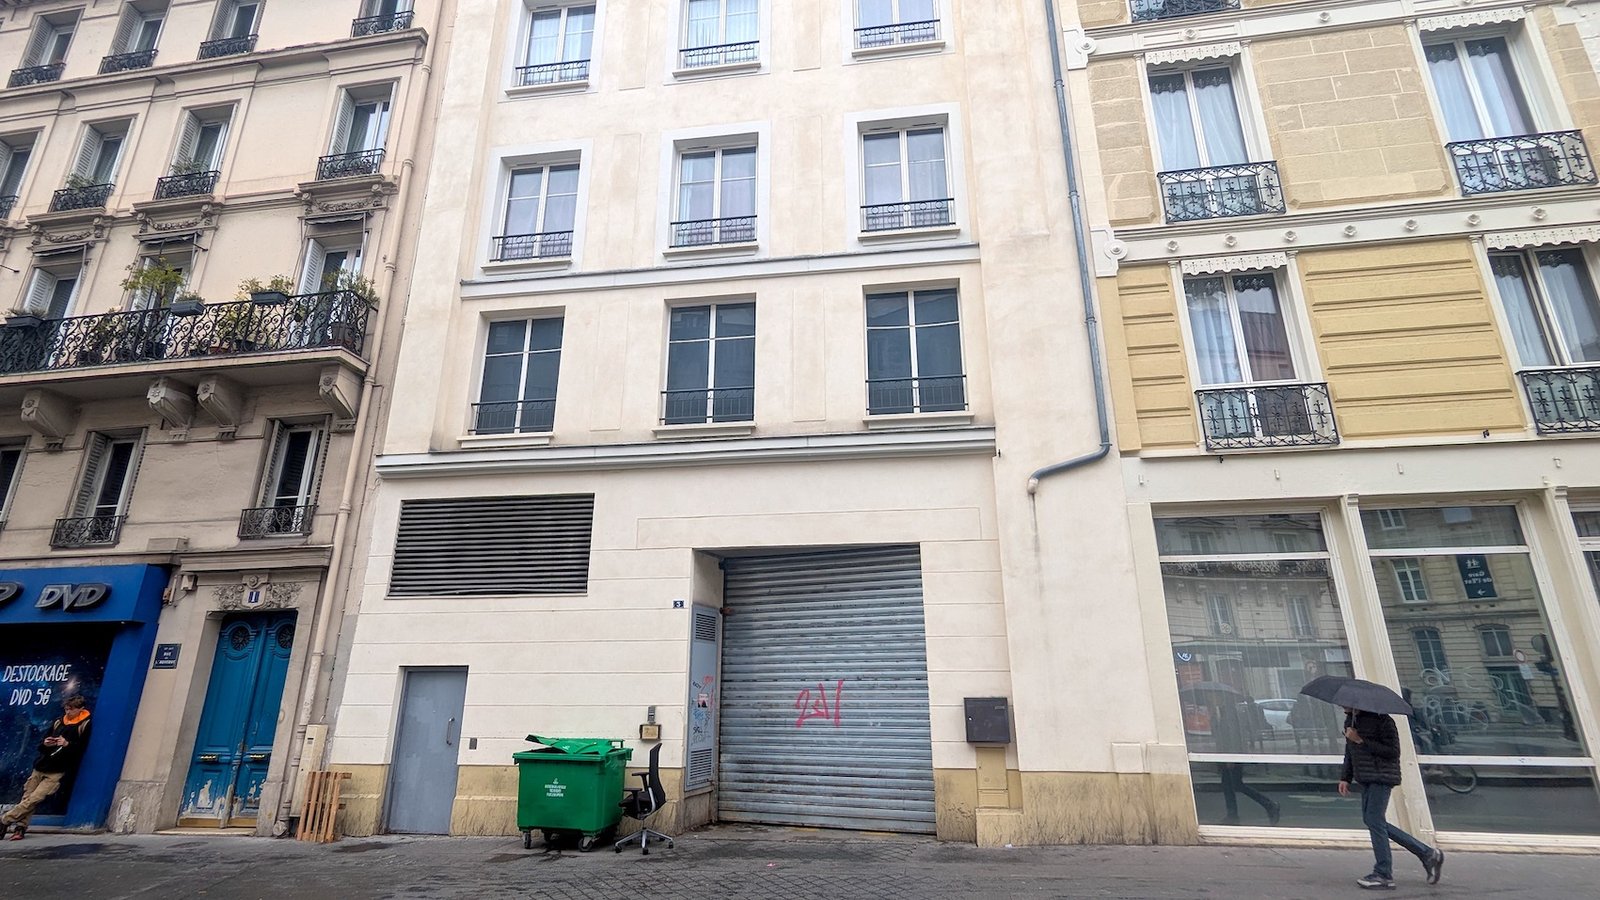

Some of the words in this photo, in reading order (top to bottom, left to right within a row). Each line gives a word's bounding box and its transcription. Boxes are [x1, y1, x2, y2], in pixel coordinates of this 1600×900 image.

[34, 584, 107, 611] DVD
[2, 664, 72, 682] DESTOCKAGE
[9, 688, 32, 706] DVD
